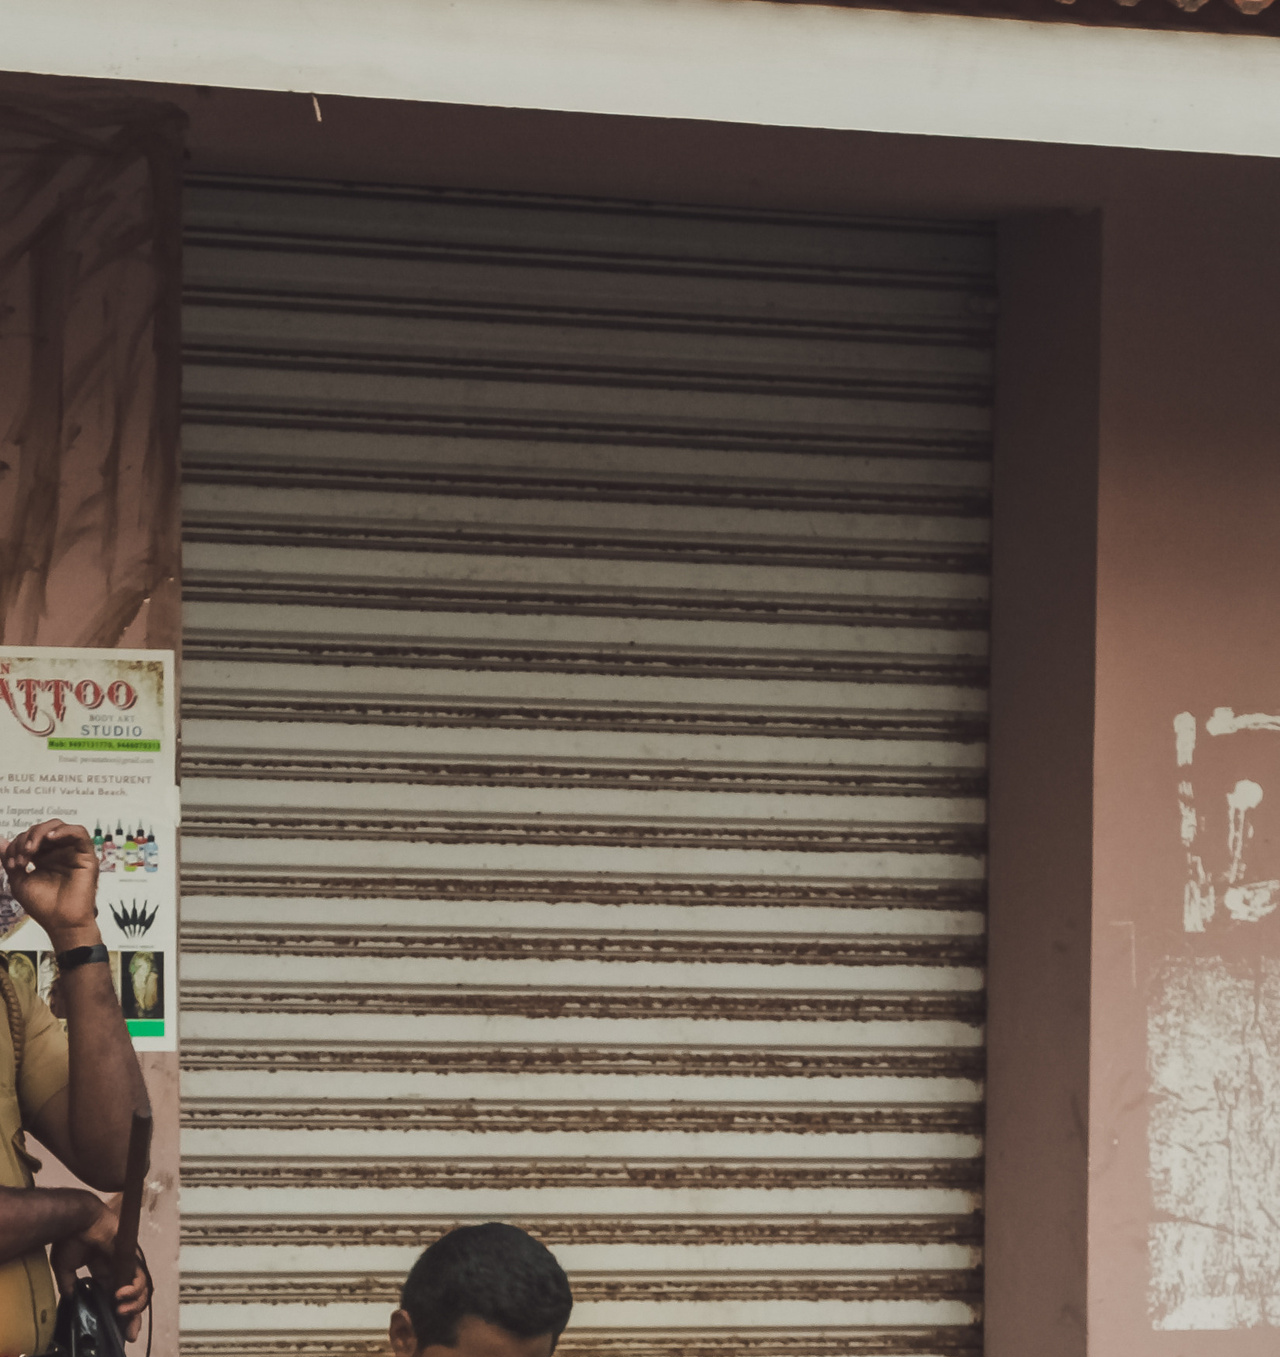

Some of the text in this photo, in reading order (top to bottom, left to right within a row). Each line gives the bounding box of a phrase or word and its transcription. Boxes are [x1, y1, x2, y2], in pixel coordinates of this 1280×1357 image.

[89, 714, 113, 722] BODY
[81, 724, 143, 737] STUDIO
[8, 773, 35, 783] BLUE
[39, 774, 83, 783] MARINE
[87, 774, 152, 784] RESTURENT
[13, 786, 31, 795] End
[34, 786, 57, 795] Cliff
[60, 787, 95, 796] Varkala
[6, 805, 44, 817] Imported
[46, 806, 78, 816] Colours
[12, 818, 34, 828] More
